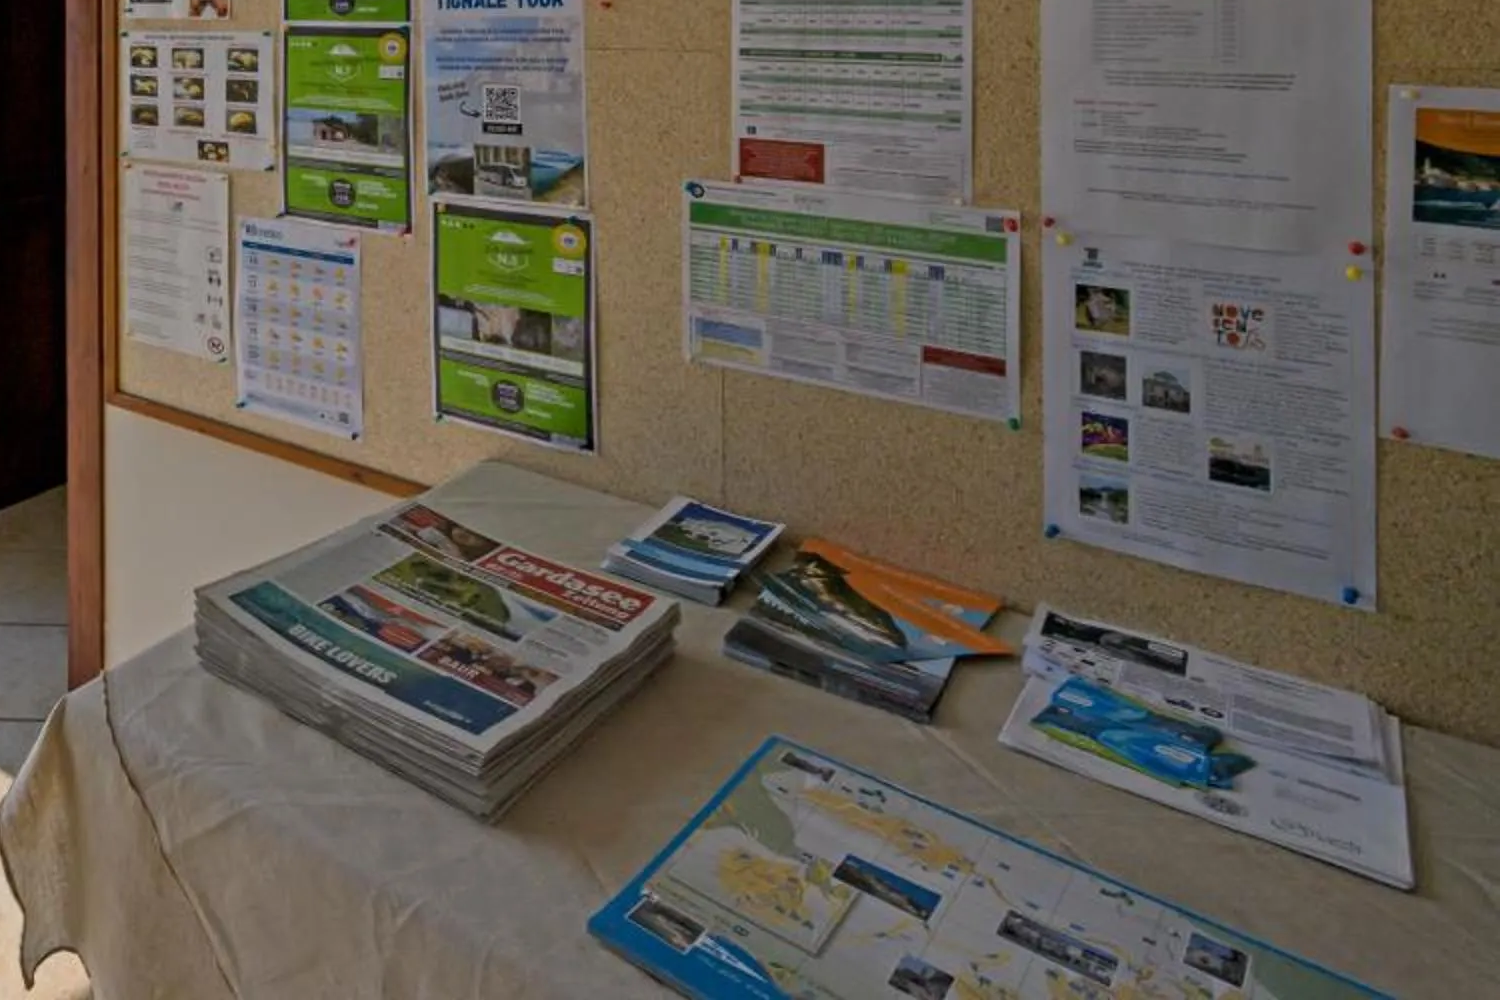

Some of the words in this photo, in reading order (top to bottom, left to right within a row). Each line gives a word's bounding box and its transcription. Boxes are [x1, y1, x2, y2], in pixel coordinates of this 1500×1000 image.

[497, 552, 642, 612] Gardasee
[288, 623, 333, 656] BIKE
[329, 644, 398, 685] LOVERS
